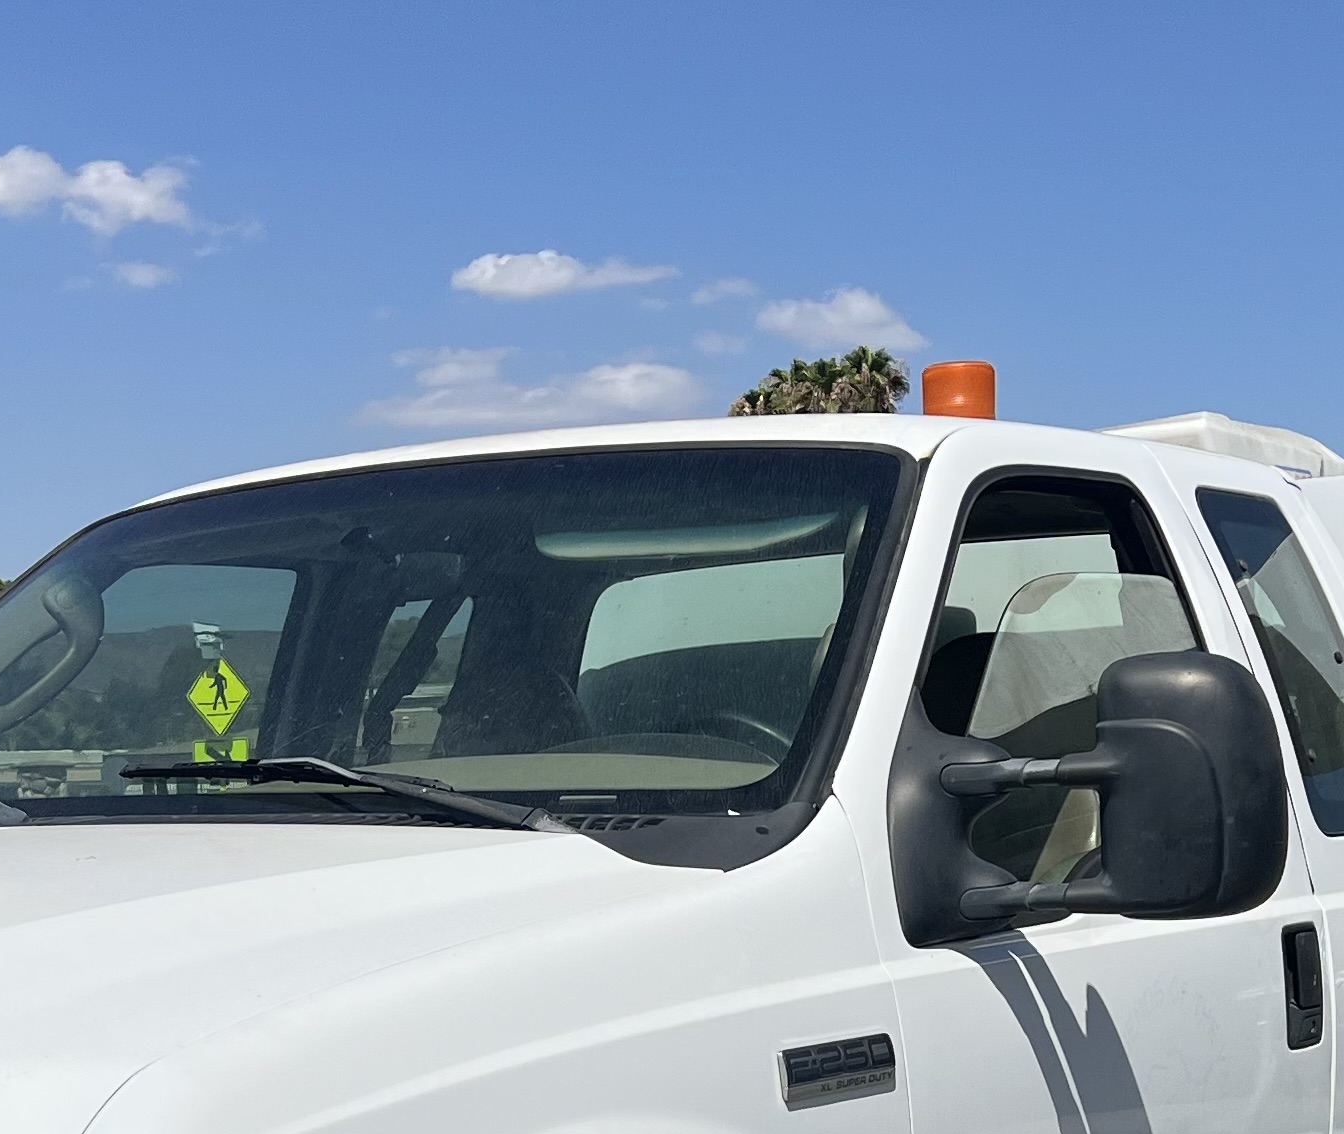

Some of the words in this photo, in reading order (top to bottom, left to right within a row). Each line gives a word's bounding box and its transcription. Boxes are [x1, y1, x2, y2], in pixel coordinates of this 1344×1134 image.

[820, 1082, 833, 1093] XL
[835, 1076, 867, 1090] SUPER
[868, 1071, 894, 1084] DUTY
